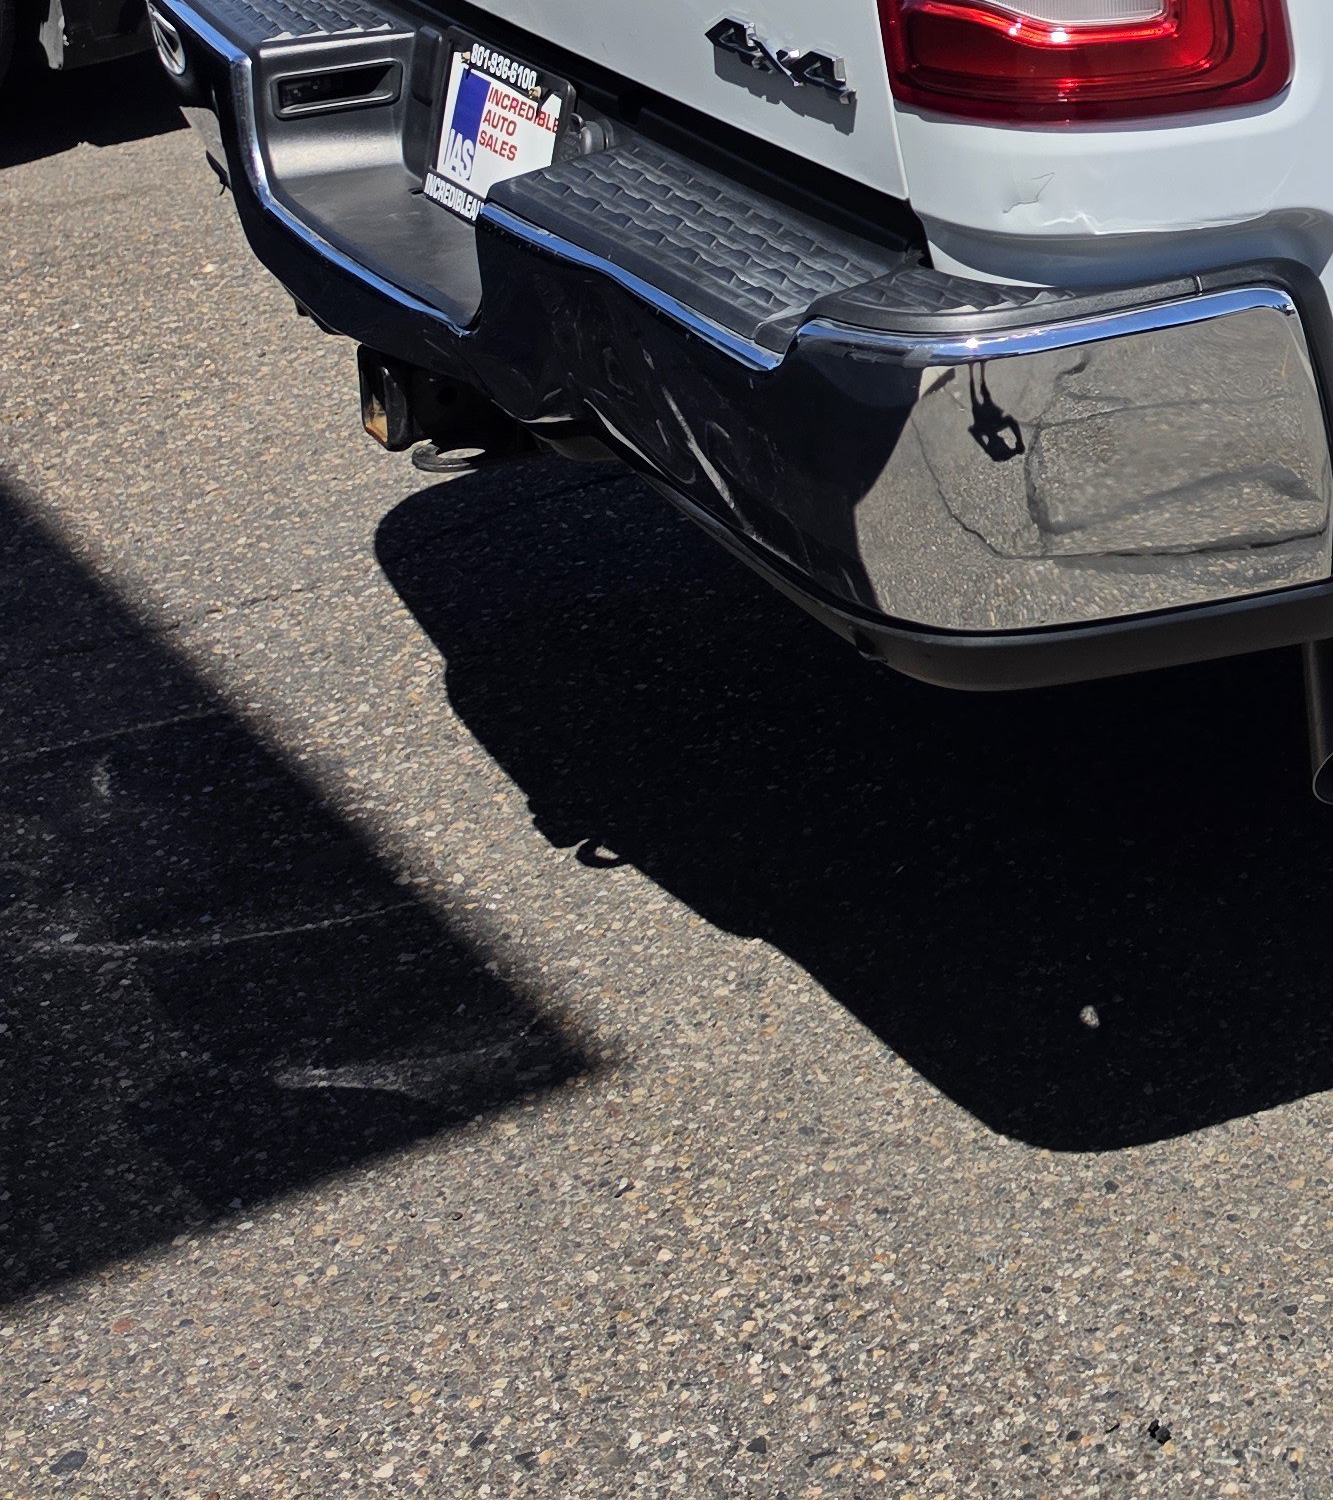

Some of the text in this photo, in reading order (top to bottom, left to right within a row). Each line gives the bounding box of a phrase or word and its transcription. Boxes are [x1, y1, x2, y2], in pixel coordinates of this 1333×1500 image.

[471, 43, 537, 91] 801-936-6100
[483, 109, 517, 137] AUTO
[479, 129, 518, 161] SALES
